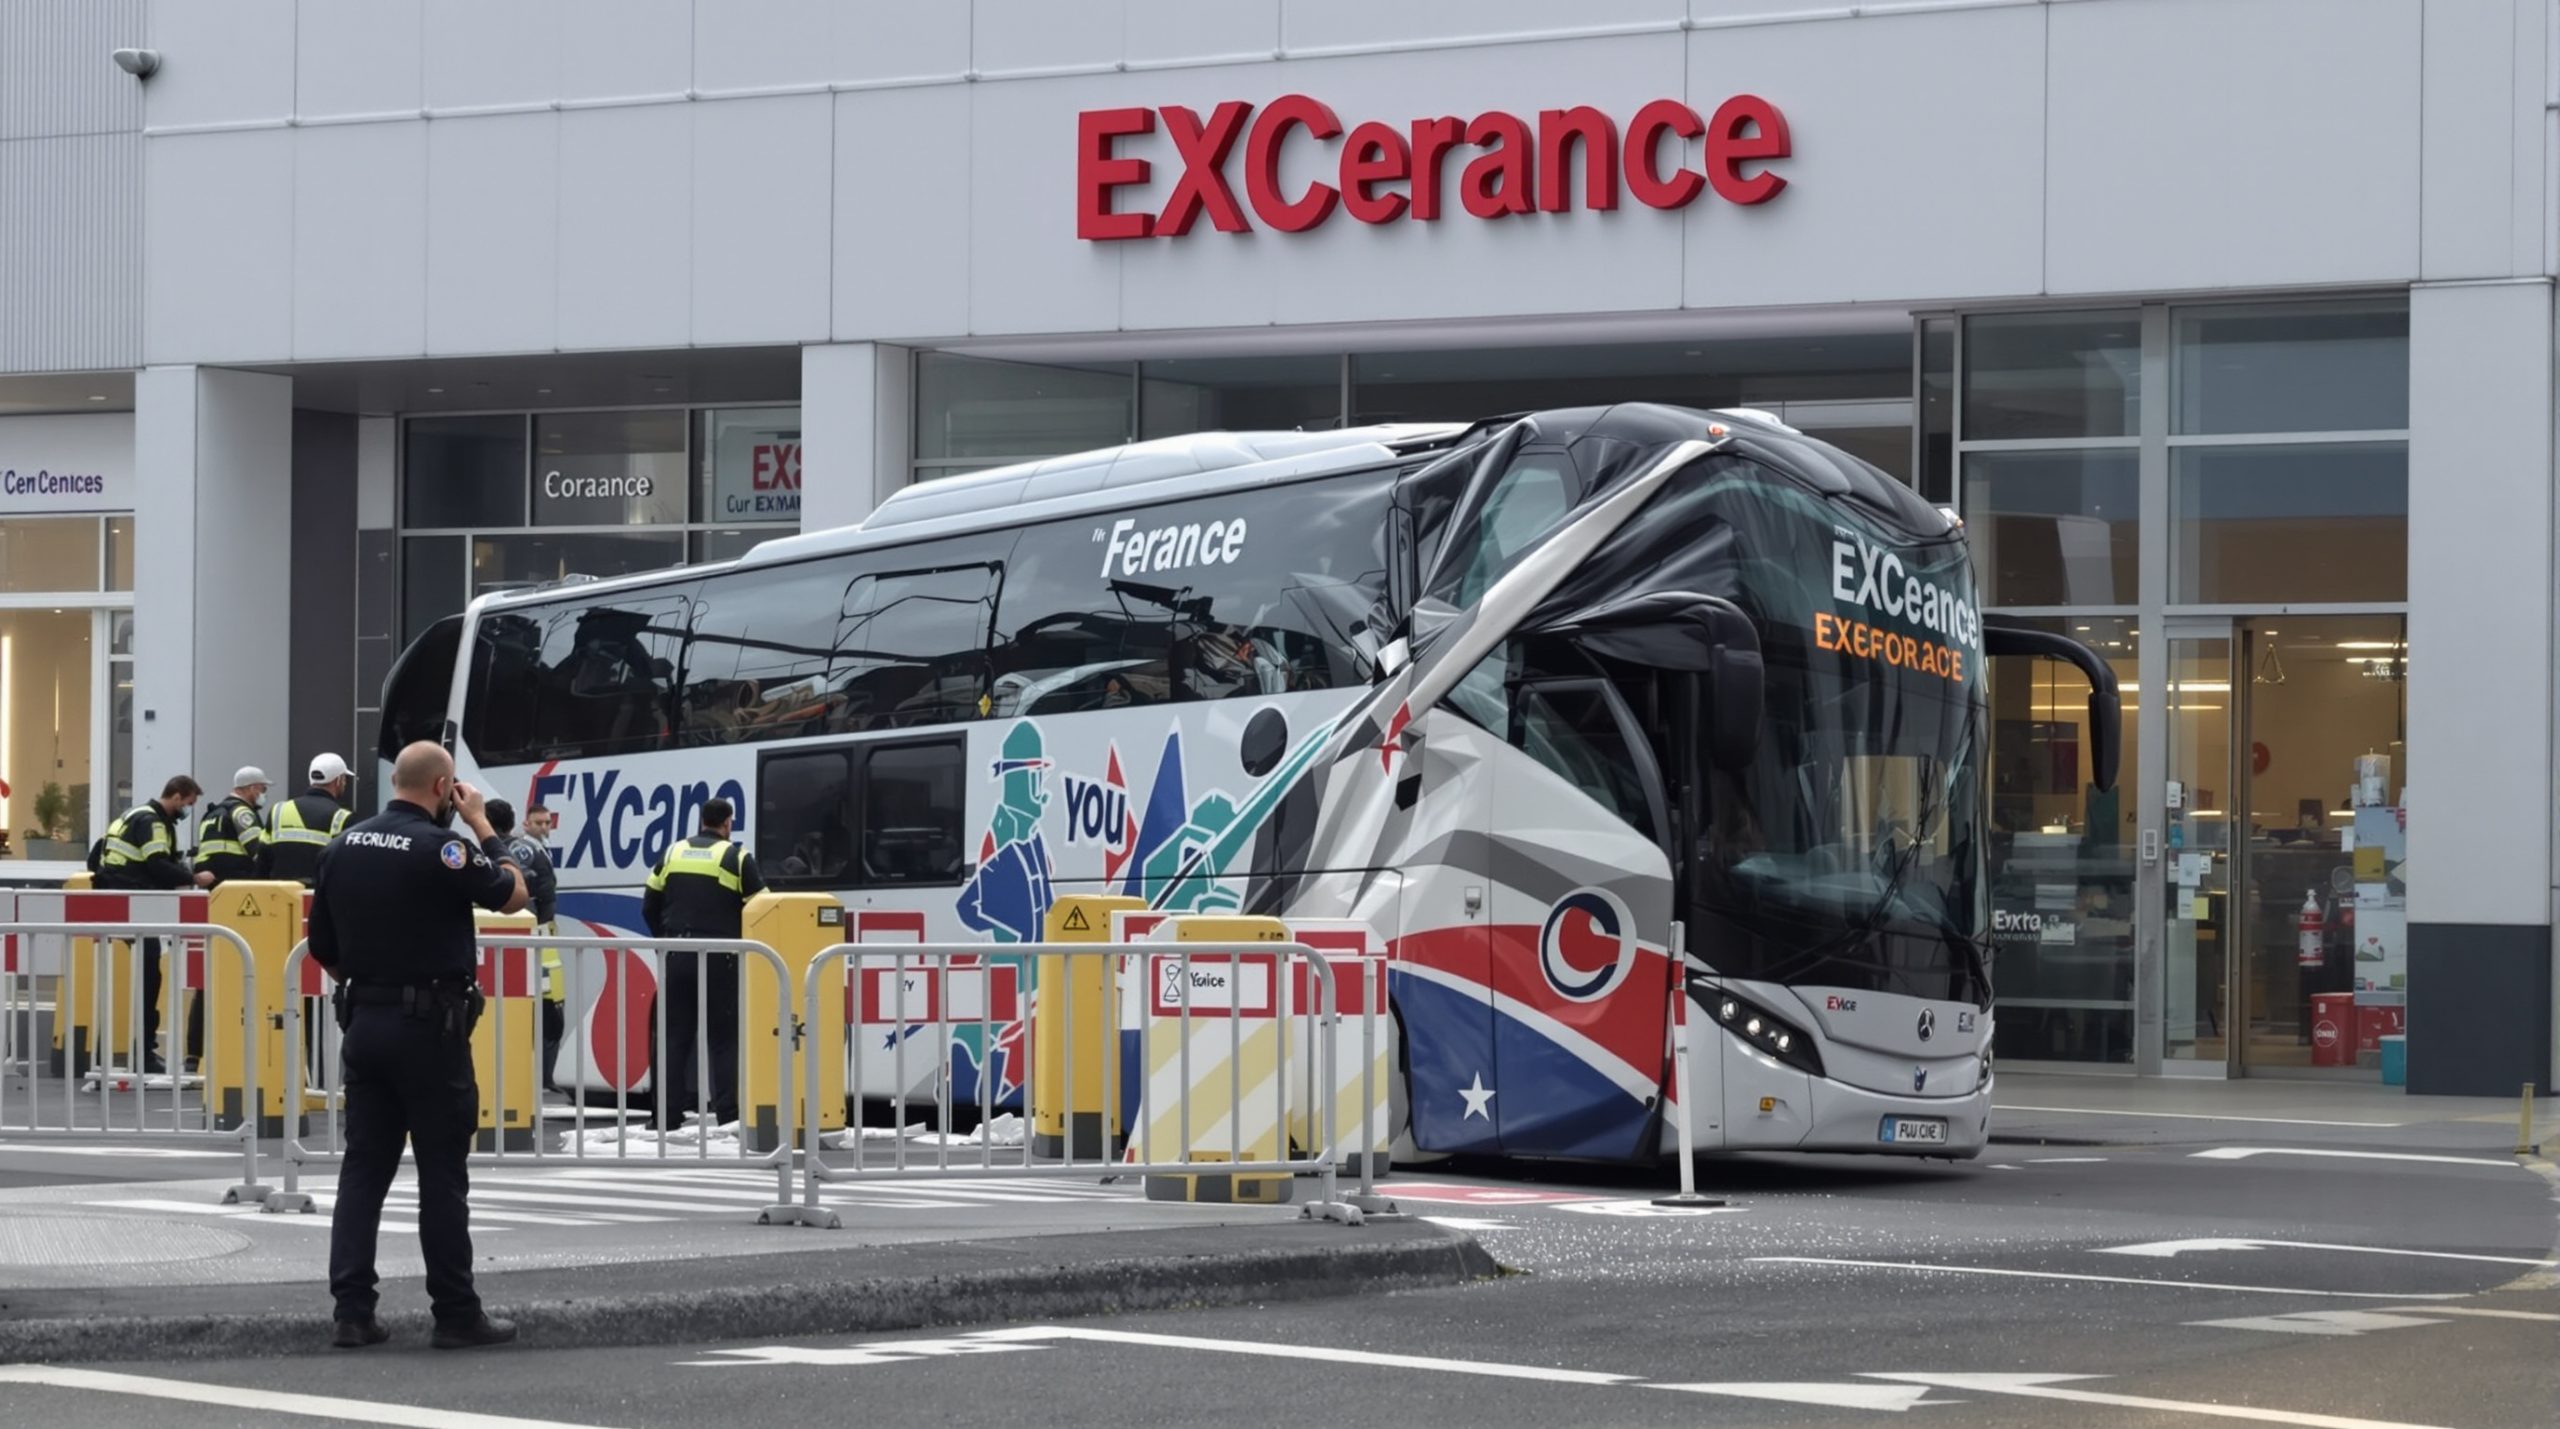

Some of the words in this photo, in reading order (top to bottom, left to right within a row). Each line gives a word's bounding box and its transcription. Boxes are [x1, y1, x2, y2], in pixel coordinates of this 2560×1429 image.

[1077, 93, 1791, 241] EXCerance
[544, 470, 651, 498] Coraance
[1100, 517, 1247, 578] Ferance
[1832, 532, 1979, 650] EXCeance
[1064, 776, 1126, 846] YOU
